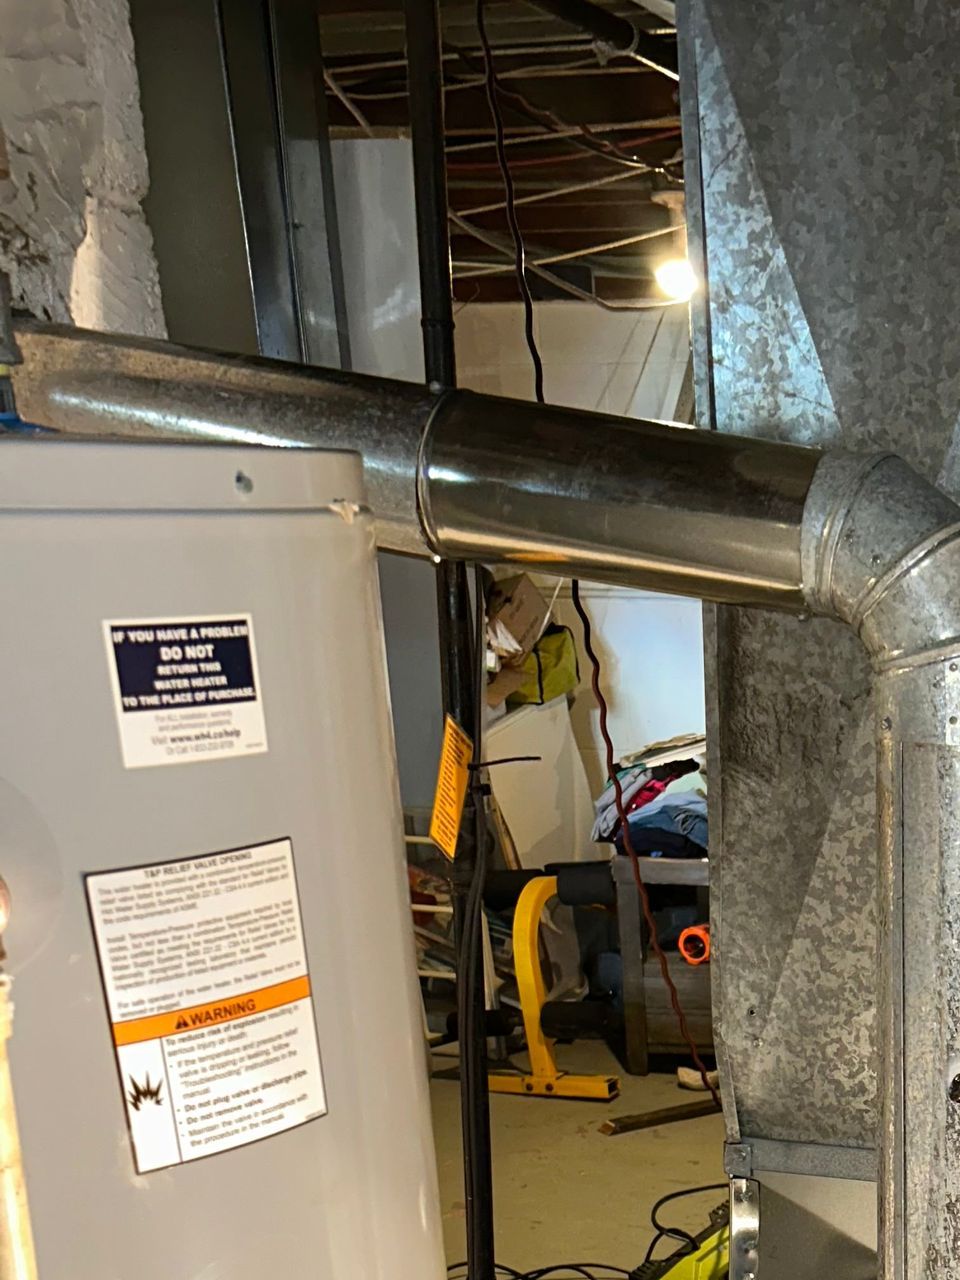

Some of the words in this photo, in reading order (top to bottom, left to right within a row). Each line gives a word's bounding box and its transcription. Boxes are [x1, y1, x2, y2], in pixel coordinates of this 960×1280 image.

[113, 631, 125, 643] IF
[127, 630, 154, 643] YOU
[156, 628, 188, 642] HAVE
[190, 628, 199, 639] A
[160, 646, 182, 661] DO
[185, 644, 215, 659] NOT
[157, 664, 198, 676] RETURN
[199, 661, 222, 672] THIS
[153, 679, 190, 690] WATER
[191, 675, 228, 688] HEATER
[122, 696, 138, 707] TO
[139, 695, 160, 706] THE
[162, 692, 193, 704] PLACE
[195, 691, 207, 702] OF
[190, 999, 256, 1026] WARNING
